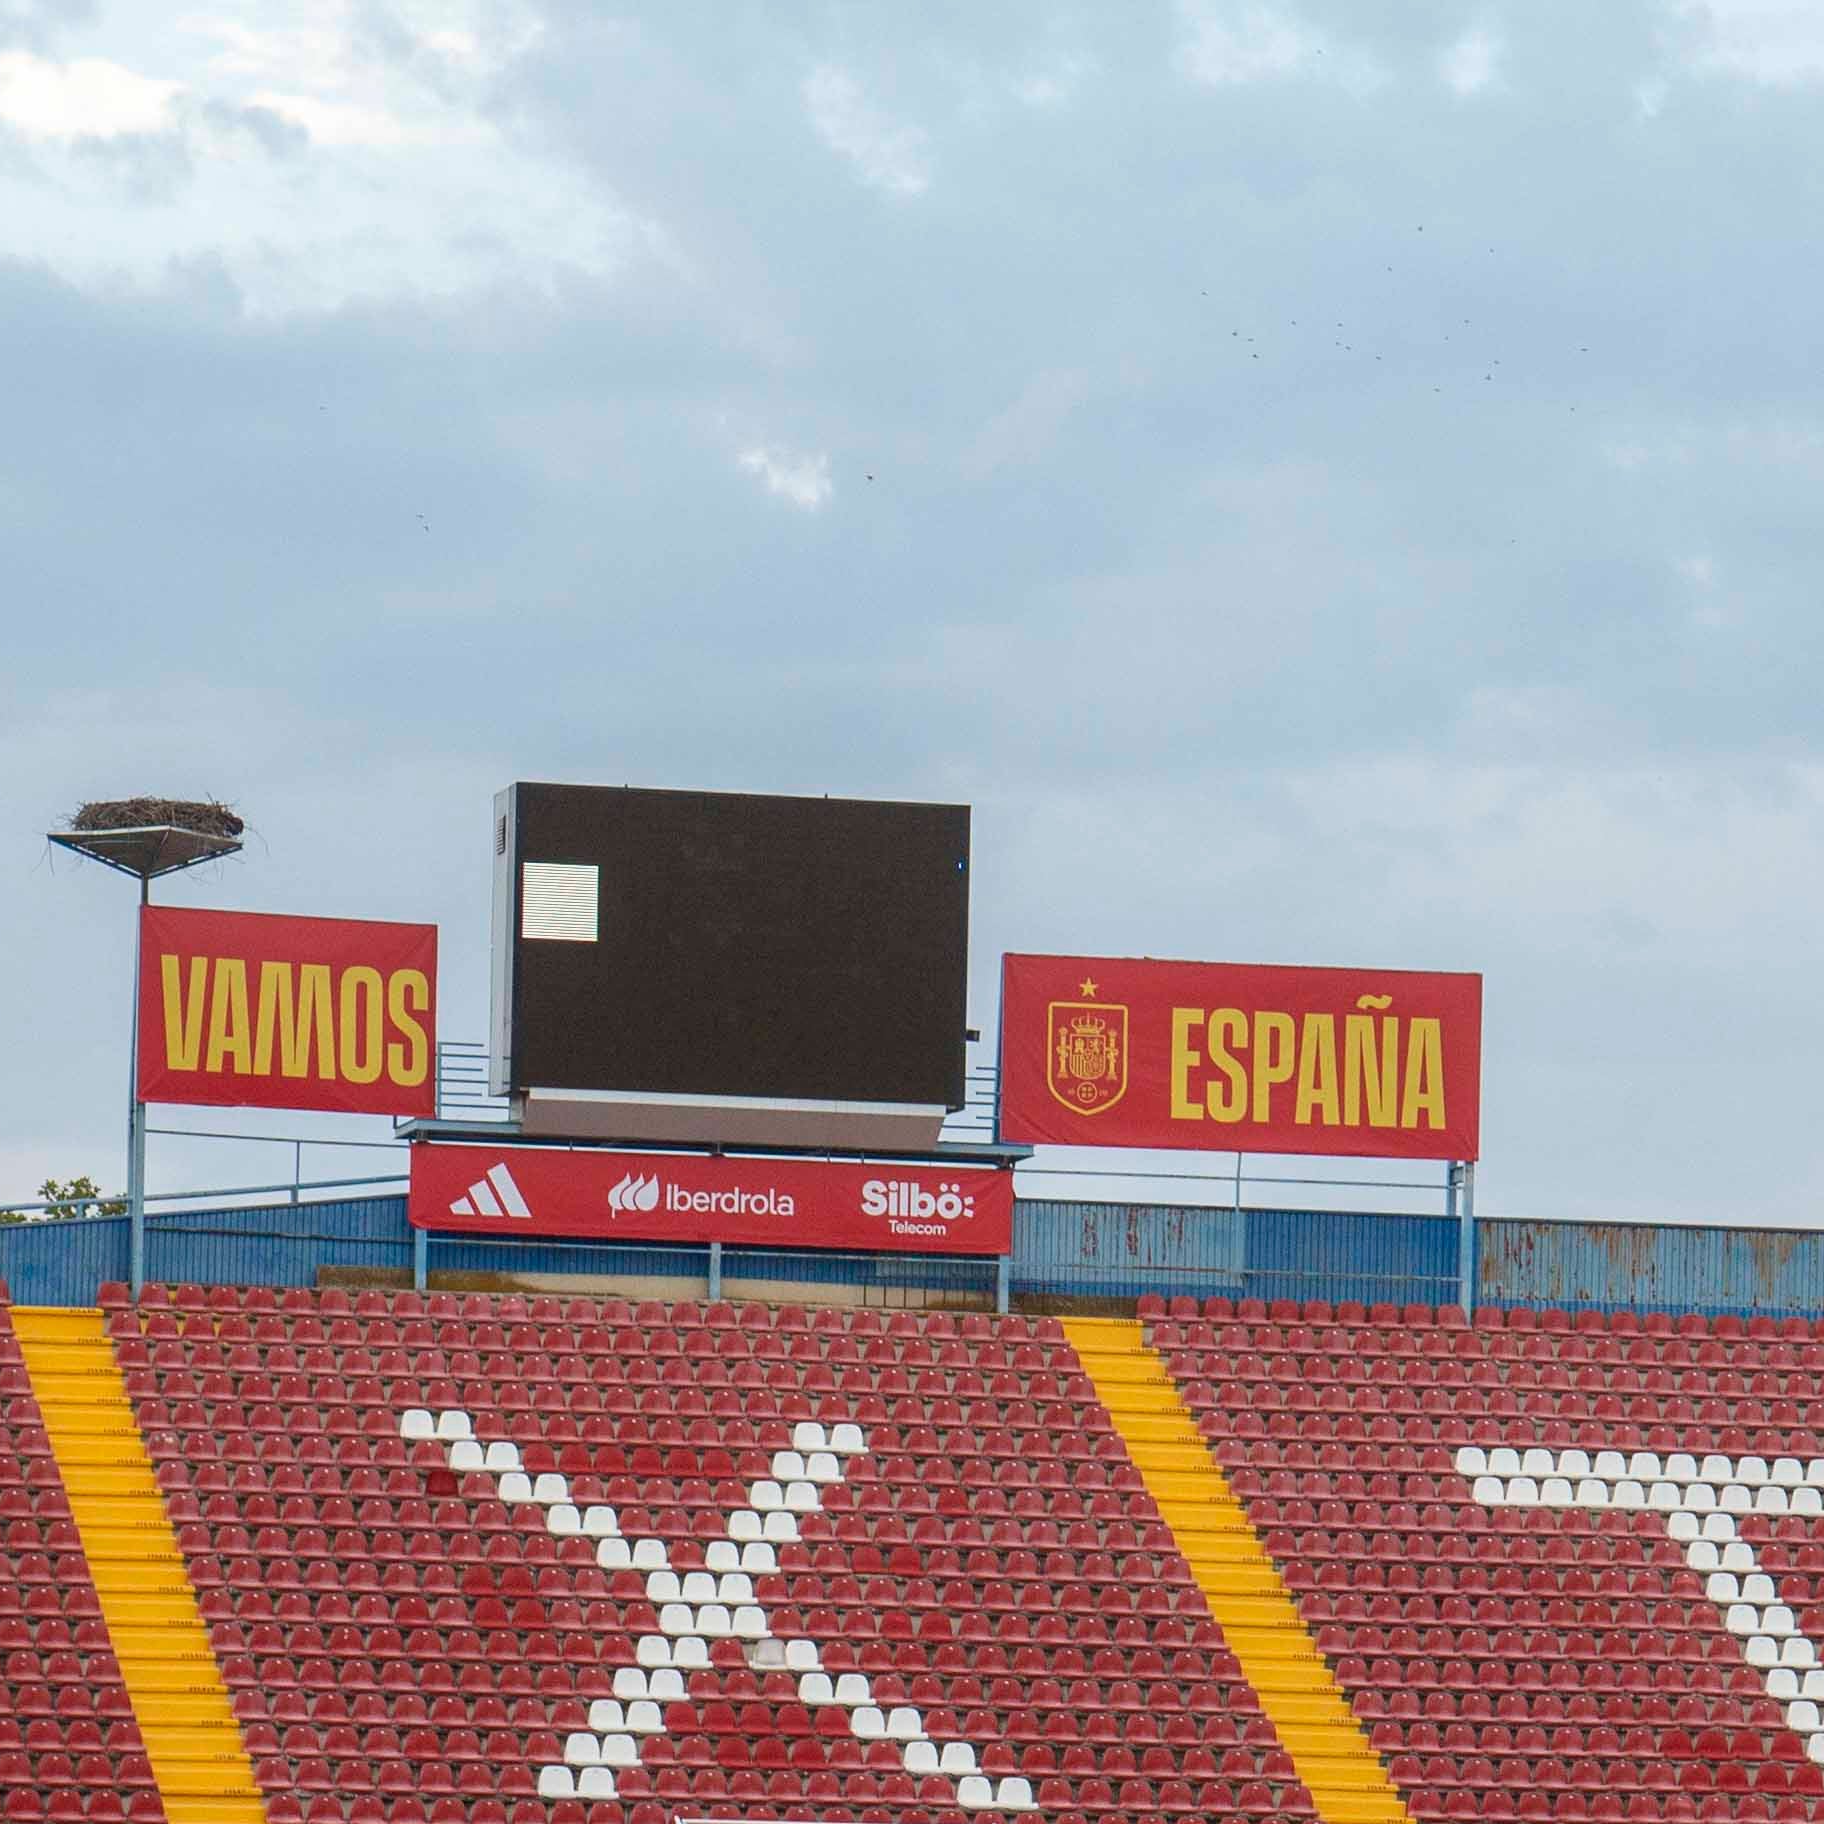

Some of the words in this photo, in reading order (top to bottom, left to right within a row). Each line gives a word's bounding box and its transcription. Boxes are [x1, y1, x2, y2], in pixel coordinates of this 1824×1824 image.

[160, 953, 430, 1088] VAMOS
[1170, 993, 1447, 1132] ESPAÑA
[665, 1183, 795, 1218] Iberdrola
[888, 1219, 947, 1237] Telecom
